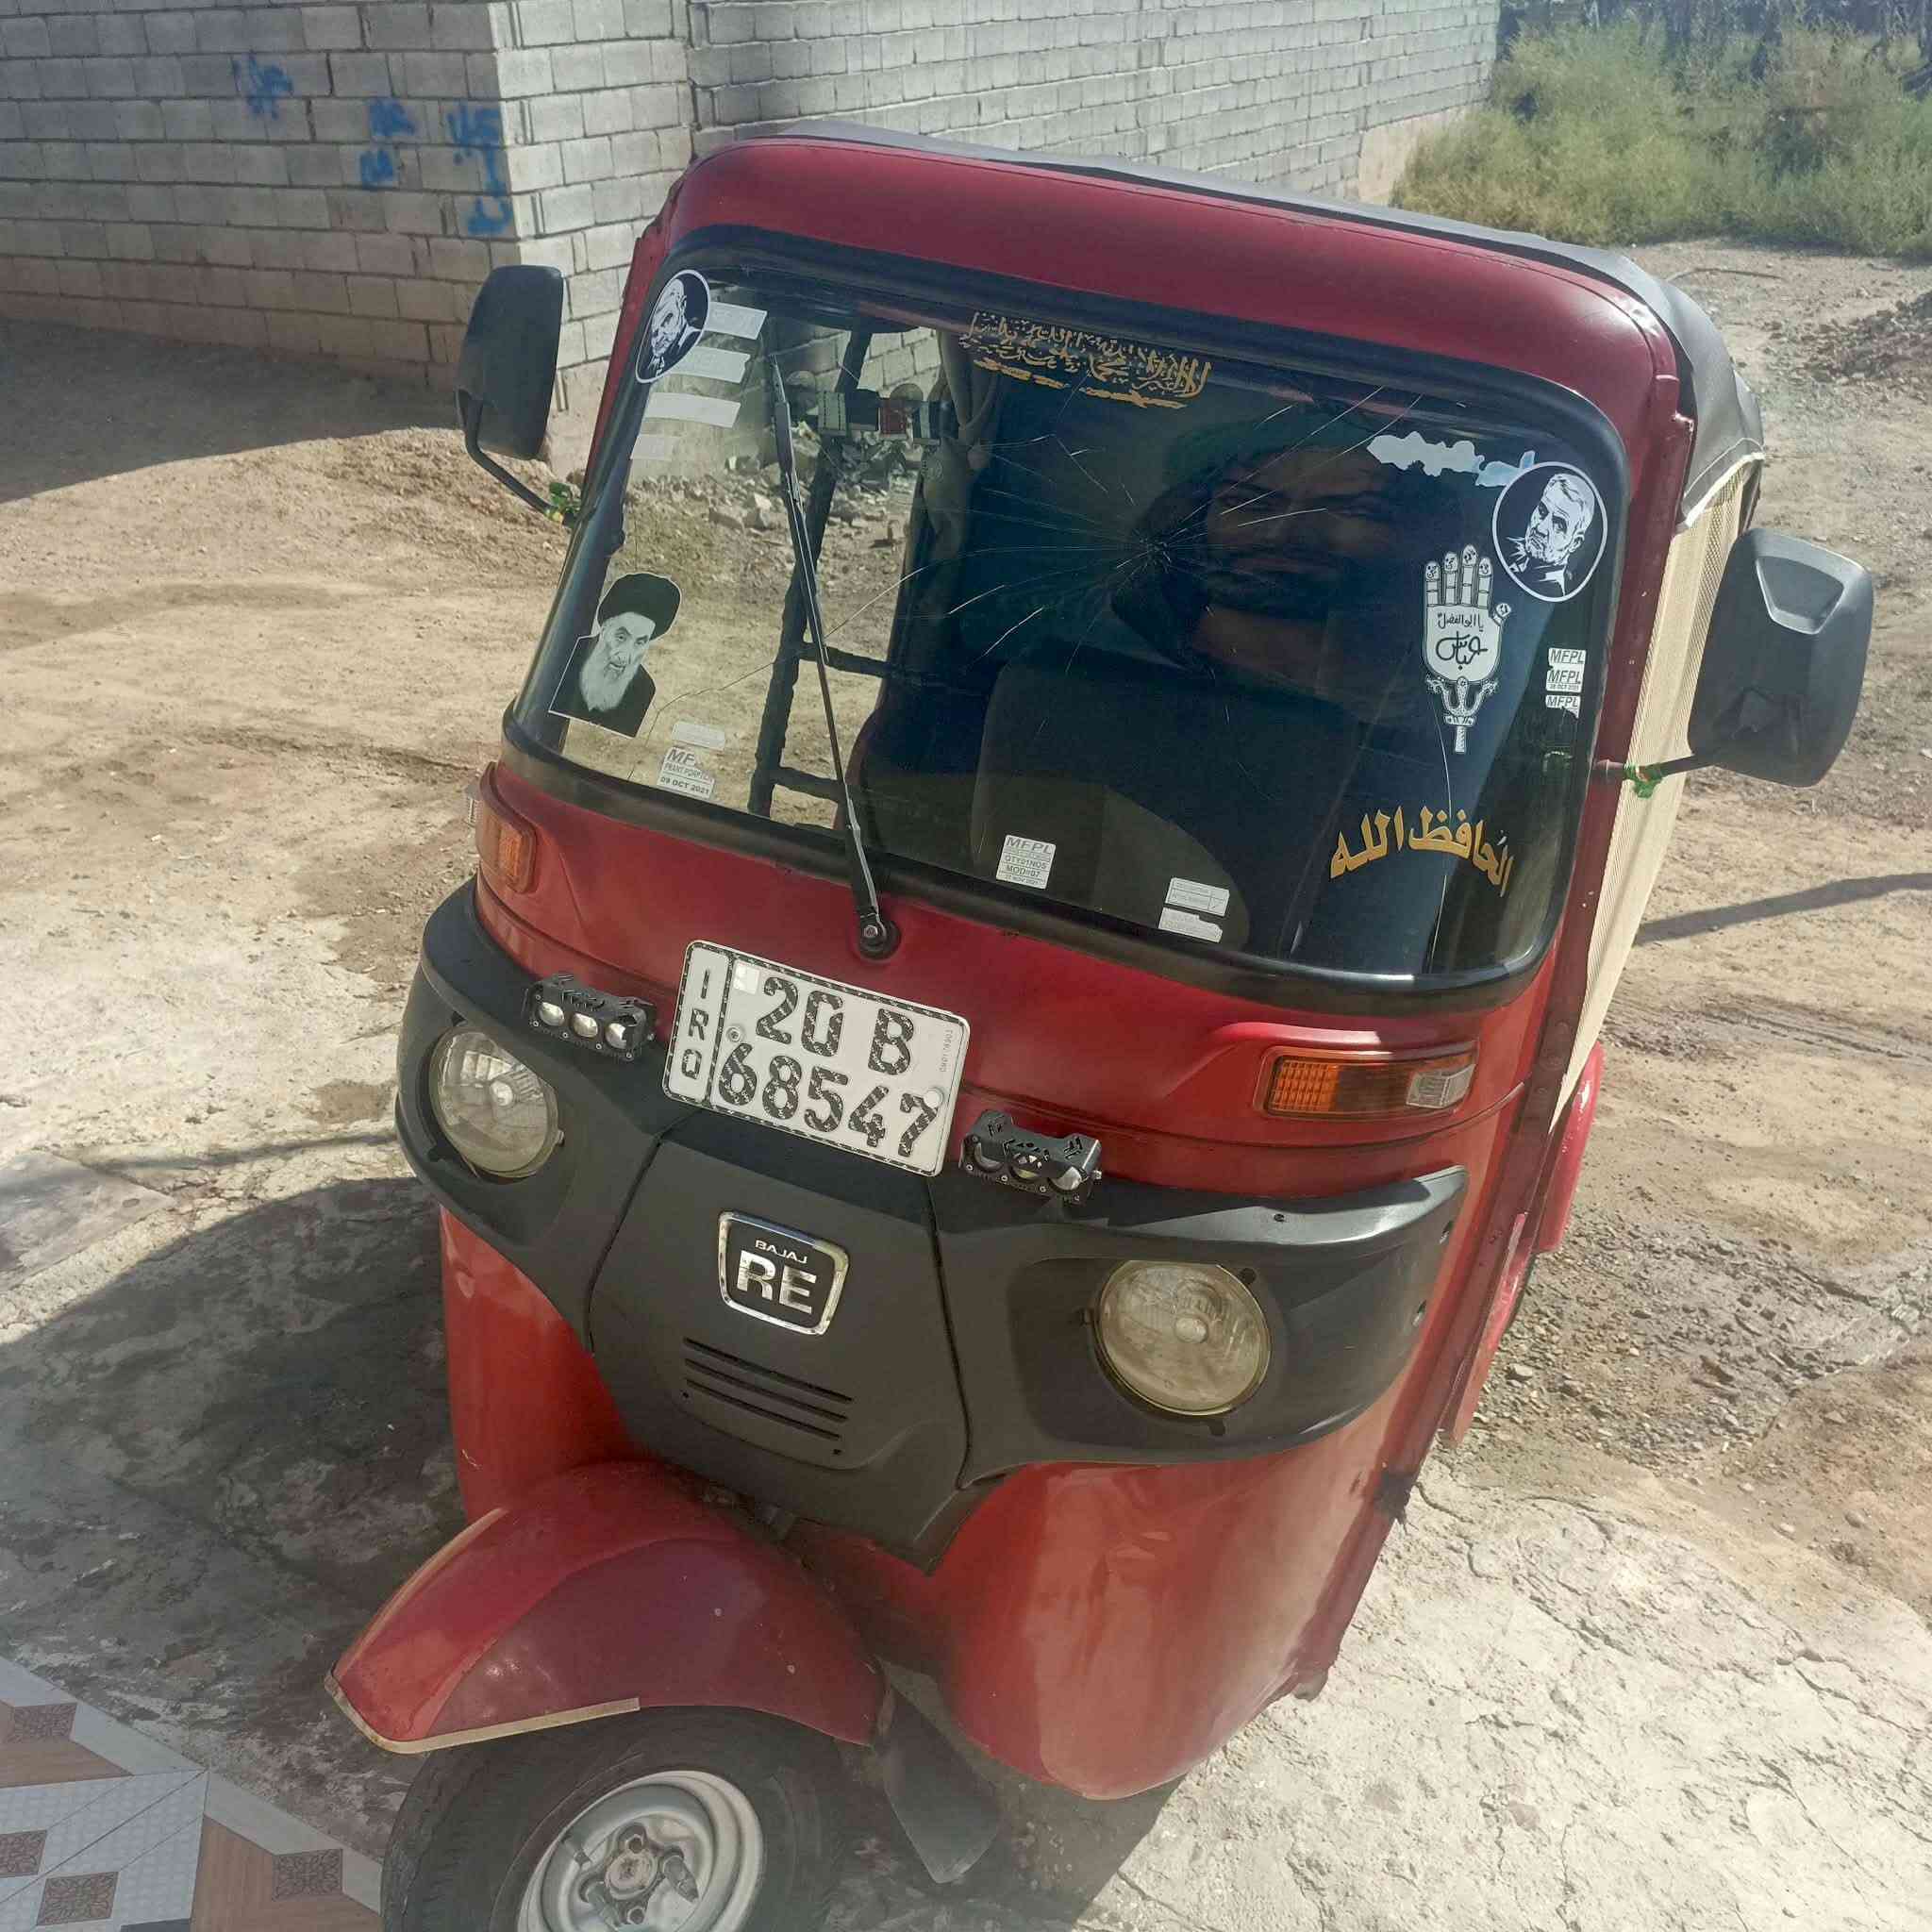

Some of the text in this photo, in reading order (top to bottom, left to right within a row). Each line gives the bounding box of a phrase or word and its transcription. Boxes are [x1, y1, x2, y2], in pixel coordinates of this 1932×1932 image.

[1436, 631, 1489, 671] عباس
[1550, 649, 1585, 664] MFPL
[1548, 669, 1582, 685] MFPL
[1547, 695, 1579, 708] MFPL
[673, 779, 689, 789] OCT
[1006, 837, 1052, 855] MFPL
[1329, 805, 1406, 880] الله
[867, 1008, 915, 1076] B
[718, 1042, 941, 1158] 68547
[755, 1240, 808, 1265] BAJAJ
[737, 1249, 818, 1315] RE
